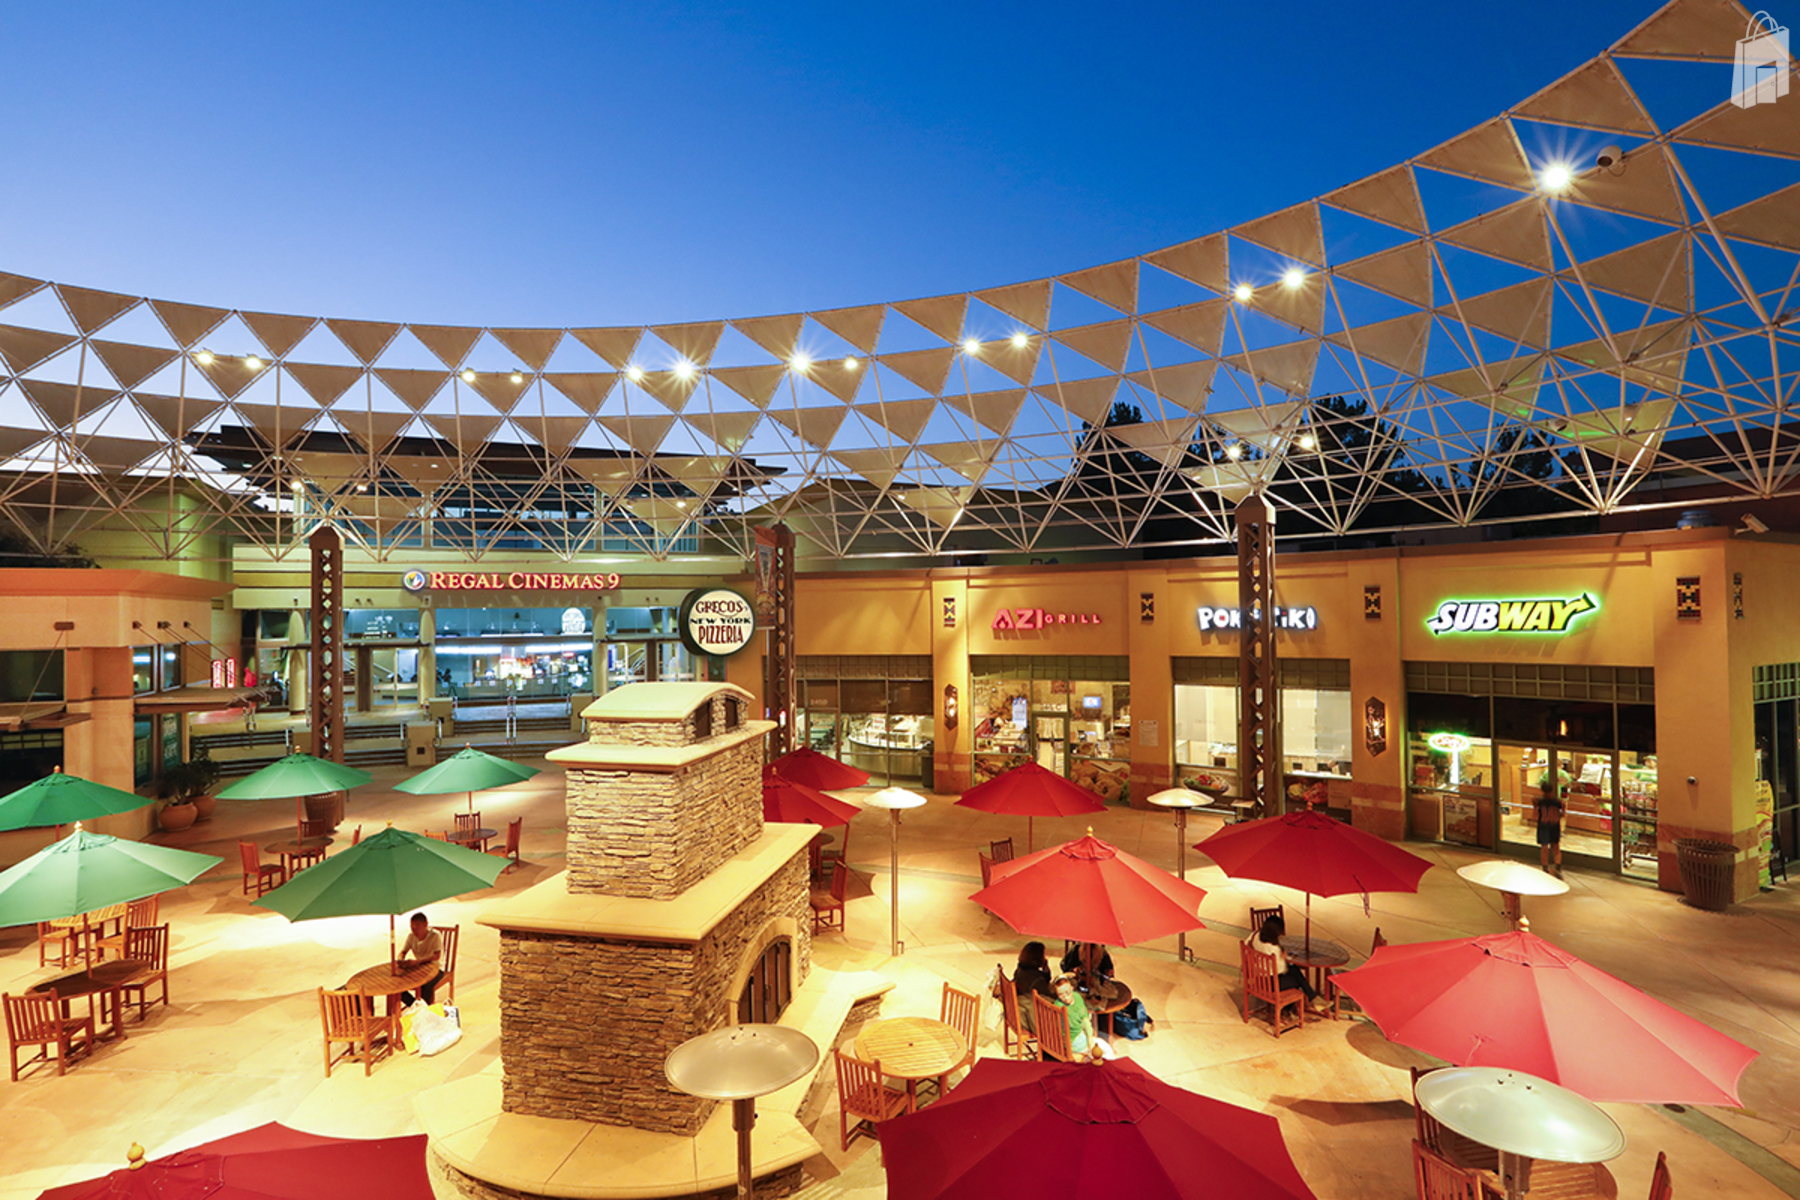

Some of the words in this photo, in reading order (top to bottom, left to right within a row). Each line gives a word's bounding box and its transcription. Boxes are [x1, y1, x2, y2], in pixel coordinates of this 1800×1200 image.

[429, 571, 504, 590] REGAL
[508, 571, 604, 590] CINEMAS
[607, 572, 620, 589] 9
[991, 608, 1044, 629] AZI
[1044, 613, 1101, 624] GRILL
[1426, 592, 1597, 634] SUBWAY
[698, 625, 744, 644] PIZZERIA
